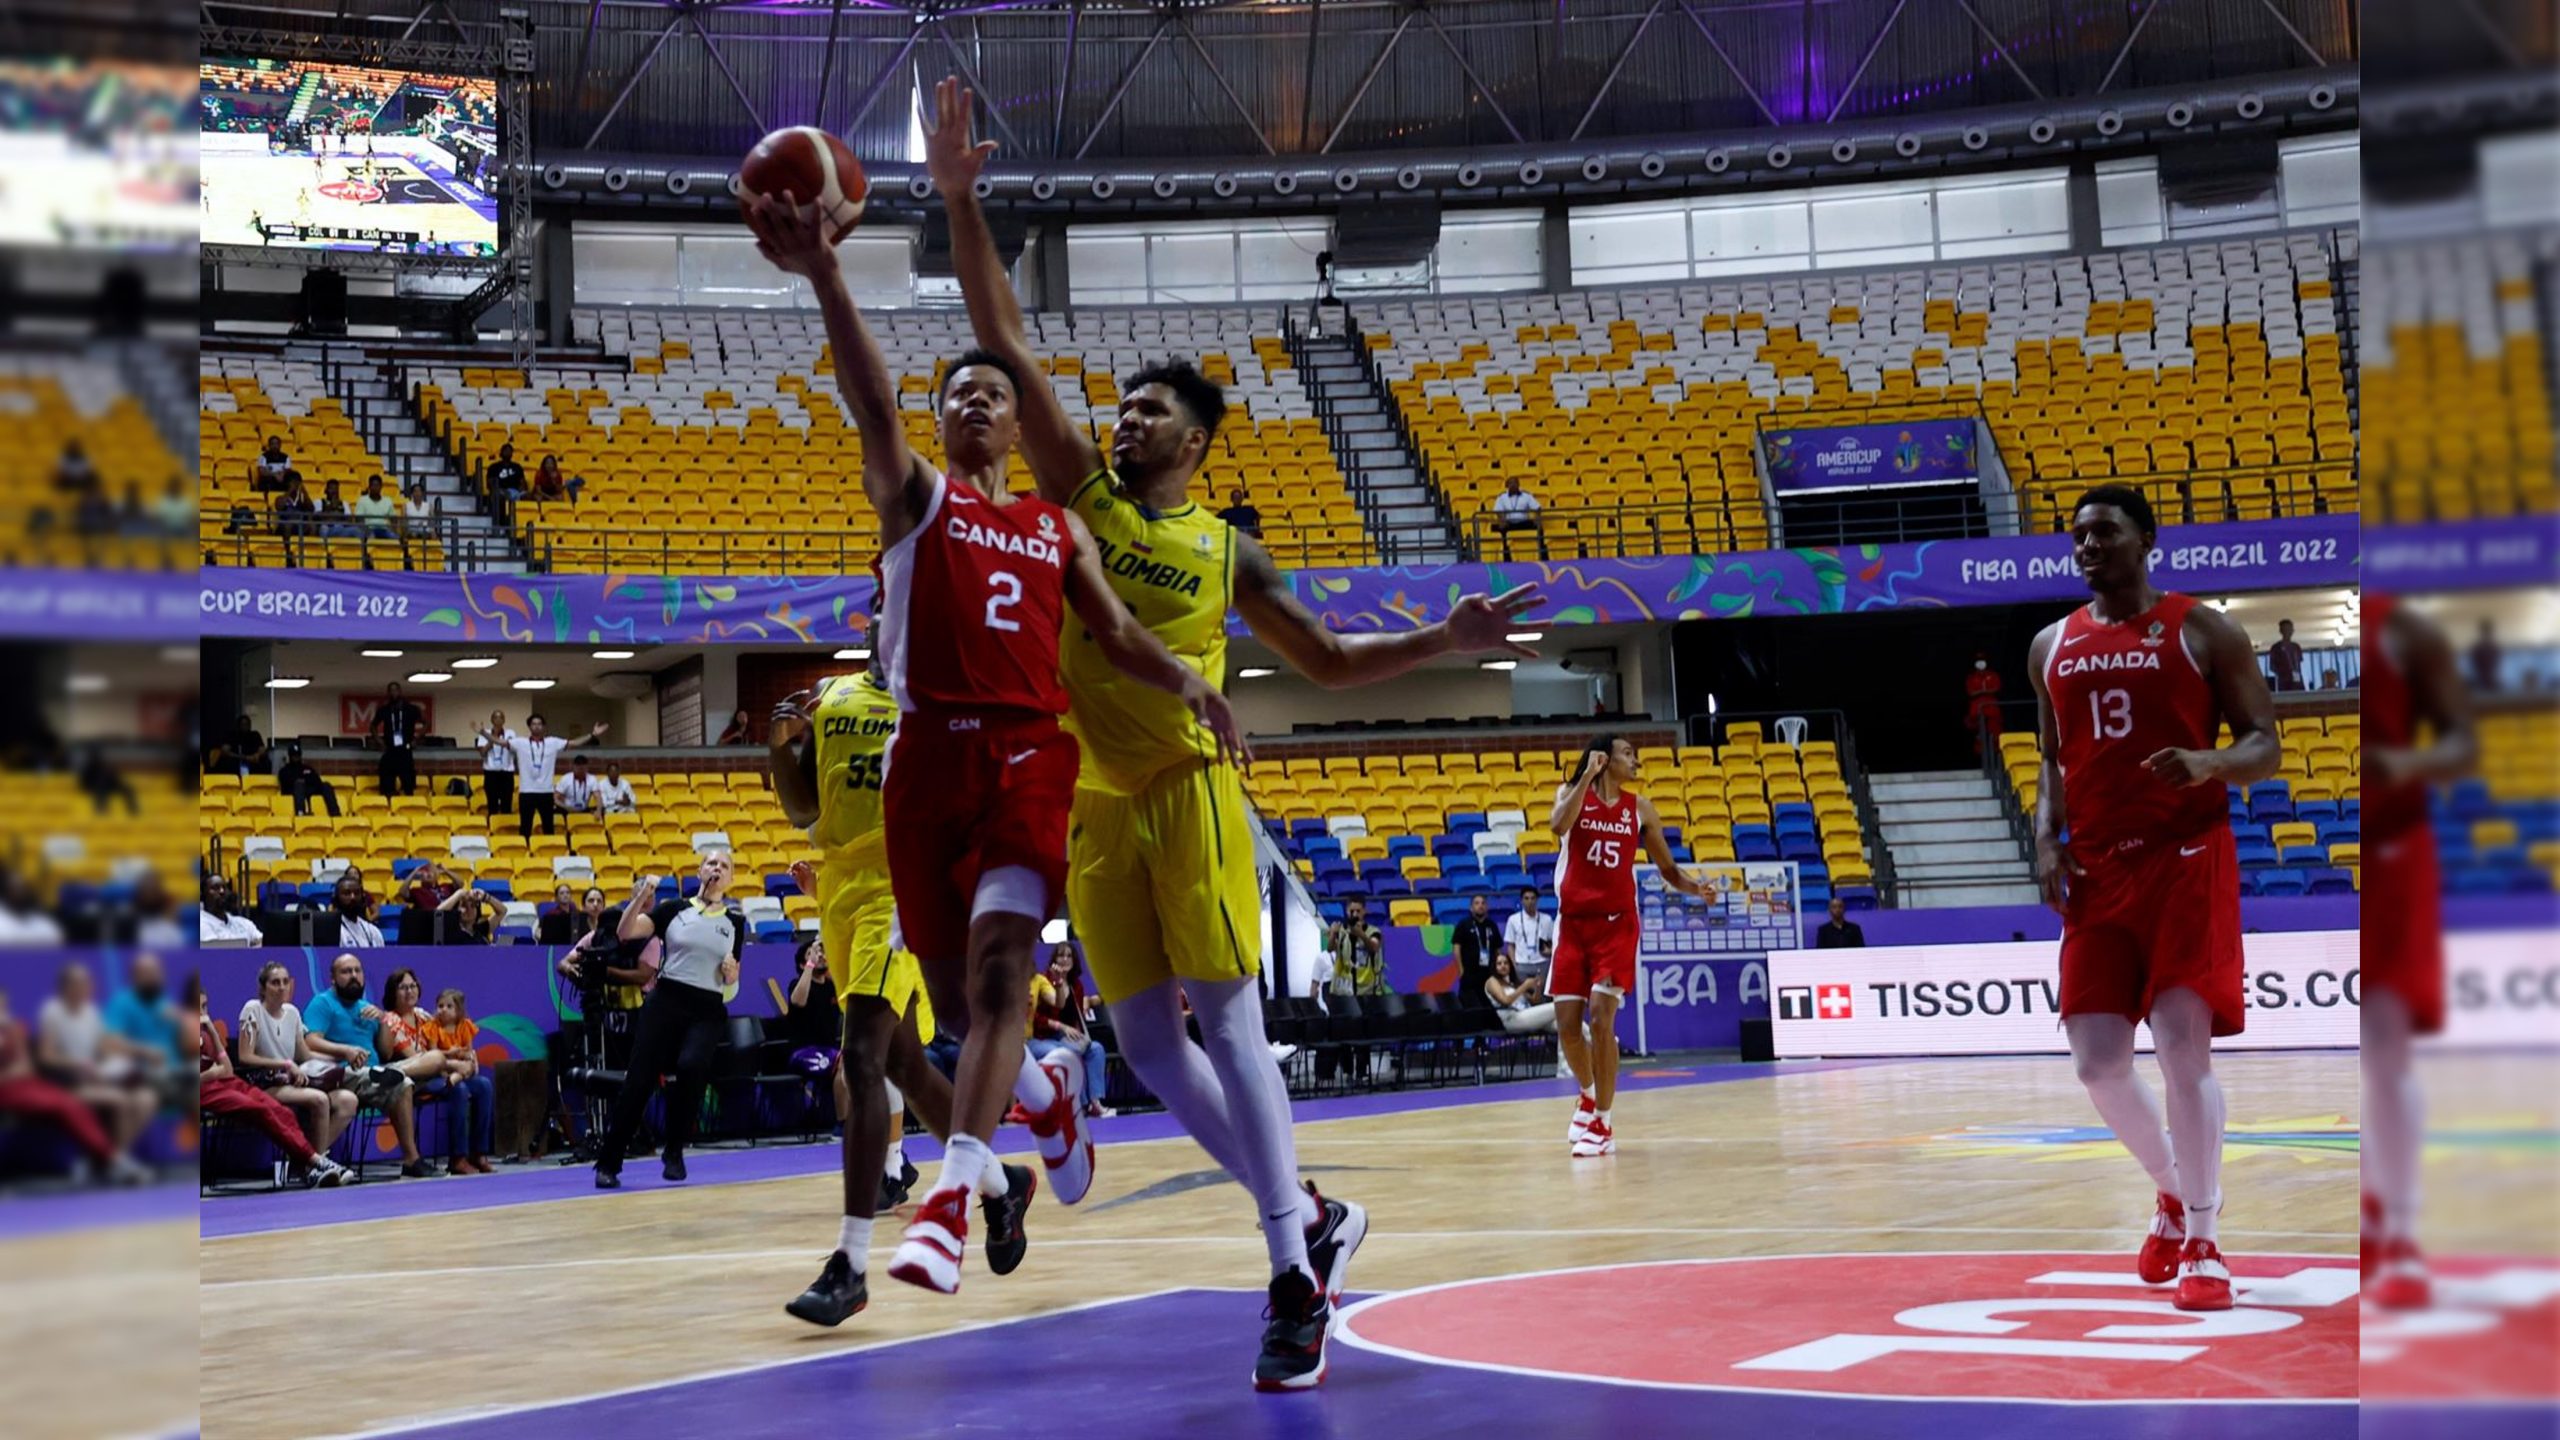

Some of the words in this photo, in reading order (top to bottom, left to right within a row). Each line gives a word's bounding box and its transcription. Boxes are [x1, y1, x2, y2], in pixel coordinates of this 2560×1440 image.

[1816, 448, 1882, 468] AMERICUP
[947, 516, 1060, 569] CANADA
[1961, 559, 2018, 584] FIBA
[2171, 542, 2268, 570] BRAZIL
[2280, 538, 2337, 563] 2022
[200, 589, 250, 614] CUP
[257, 591, 346, 616] BRAZIL
[357, 595, 409, 617] 2022
[985, 571, 1022, 632] 2
[2057, 651, 2160, 677] CANADA
[824, 716, 896, 739] COLOM
[949, 718, 980, 731] CAN
[2088, 688, 2133, 740] 13
[846, 753, 882, 791] 55
[1580, 818, 1632, 836] CANADA
[1586, 839, 1621, 868] 45
